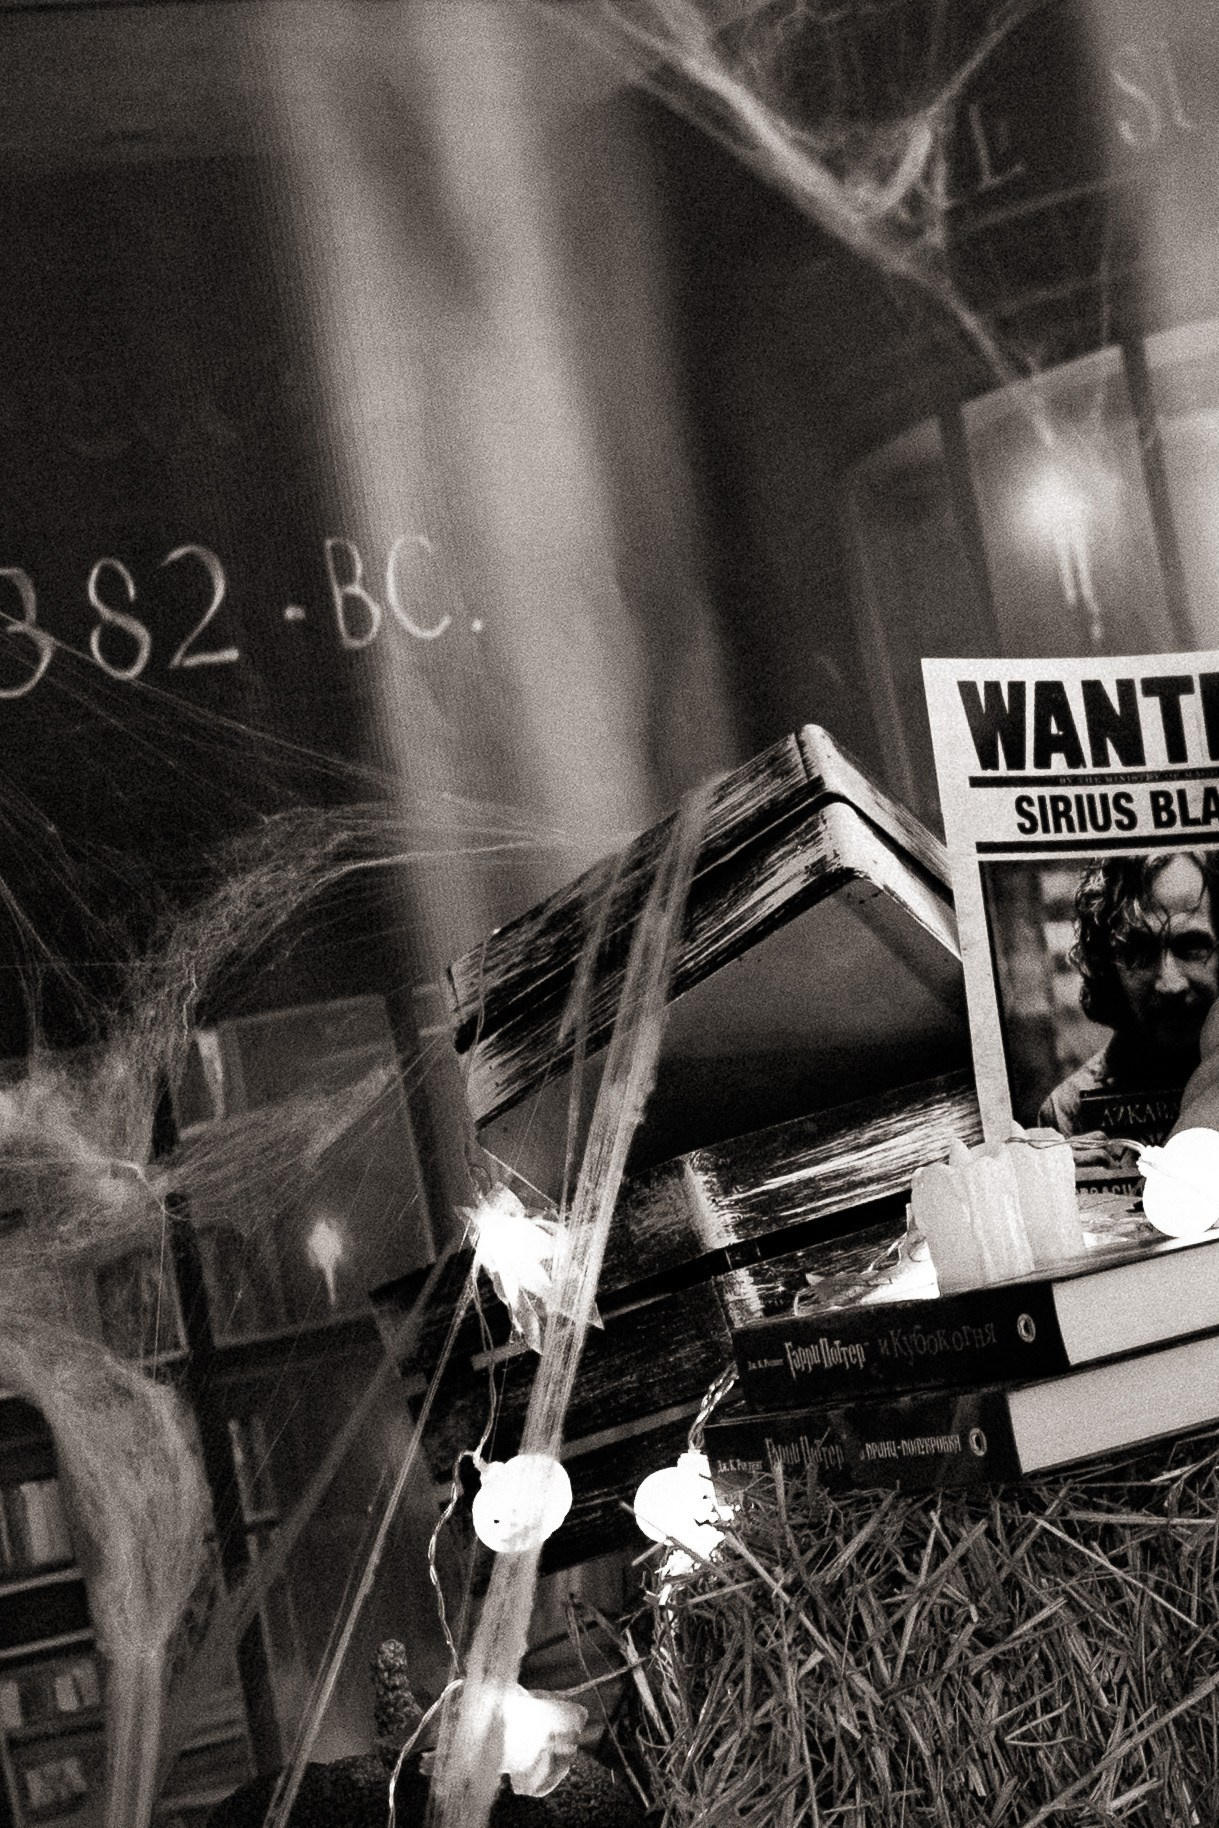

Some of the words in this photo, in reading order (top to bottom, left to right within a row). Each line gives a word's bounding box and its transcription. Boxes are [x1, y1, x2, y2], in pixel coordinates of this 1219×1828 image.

[1014, 791, 1138, 835] SIRIUS
[889, 1324, 951, 1367] Кубок
[951, 1322, 998, 1352] огня
